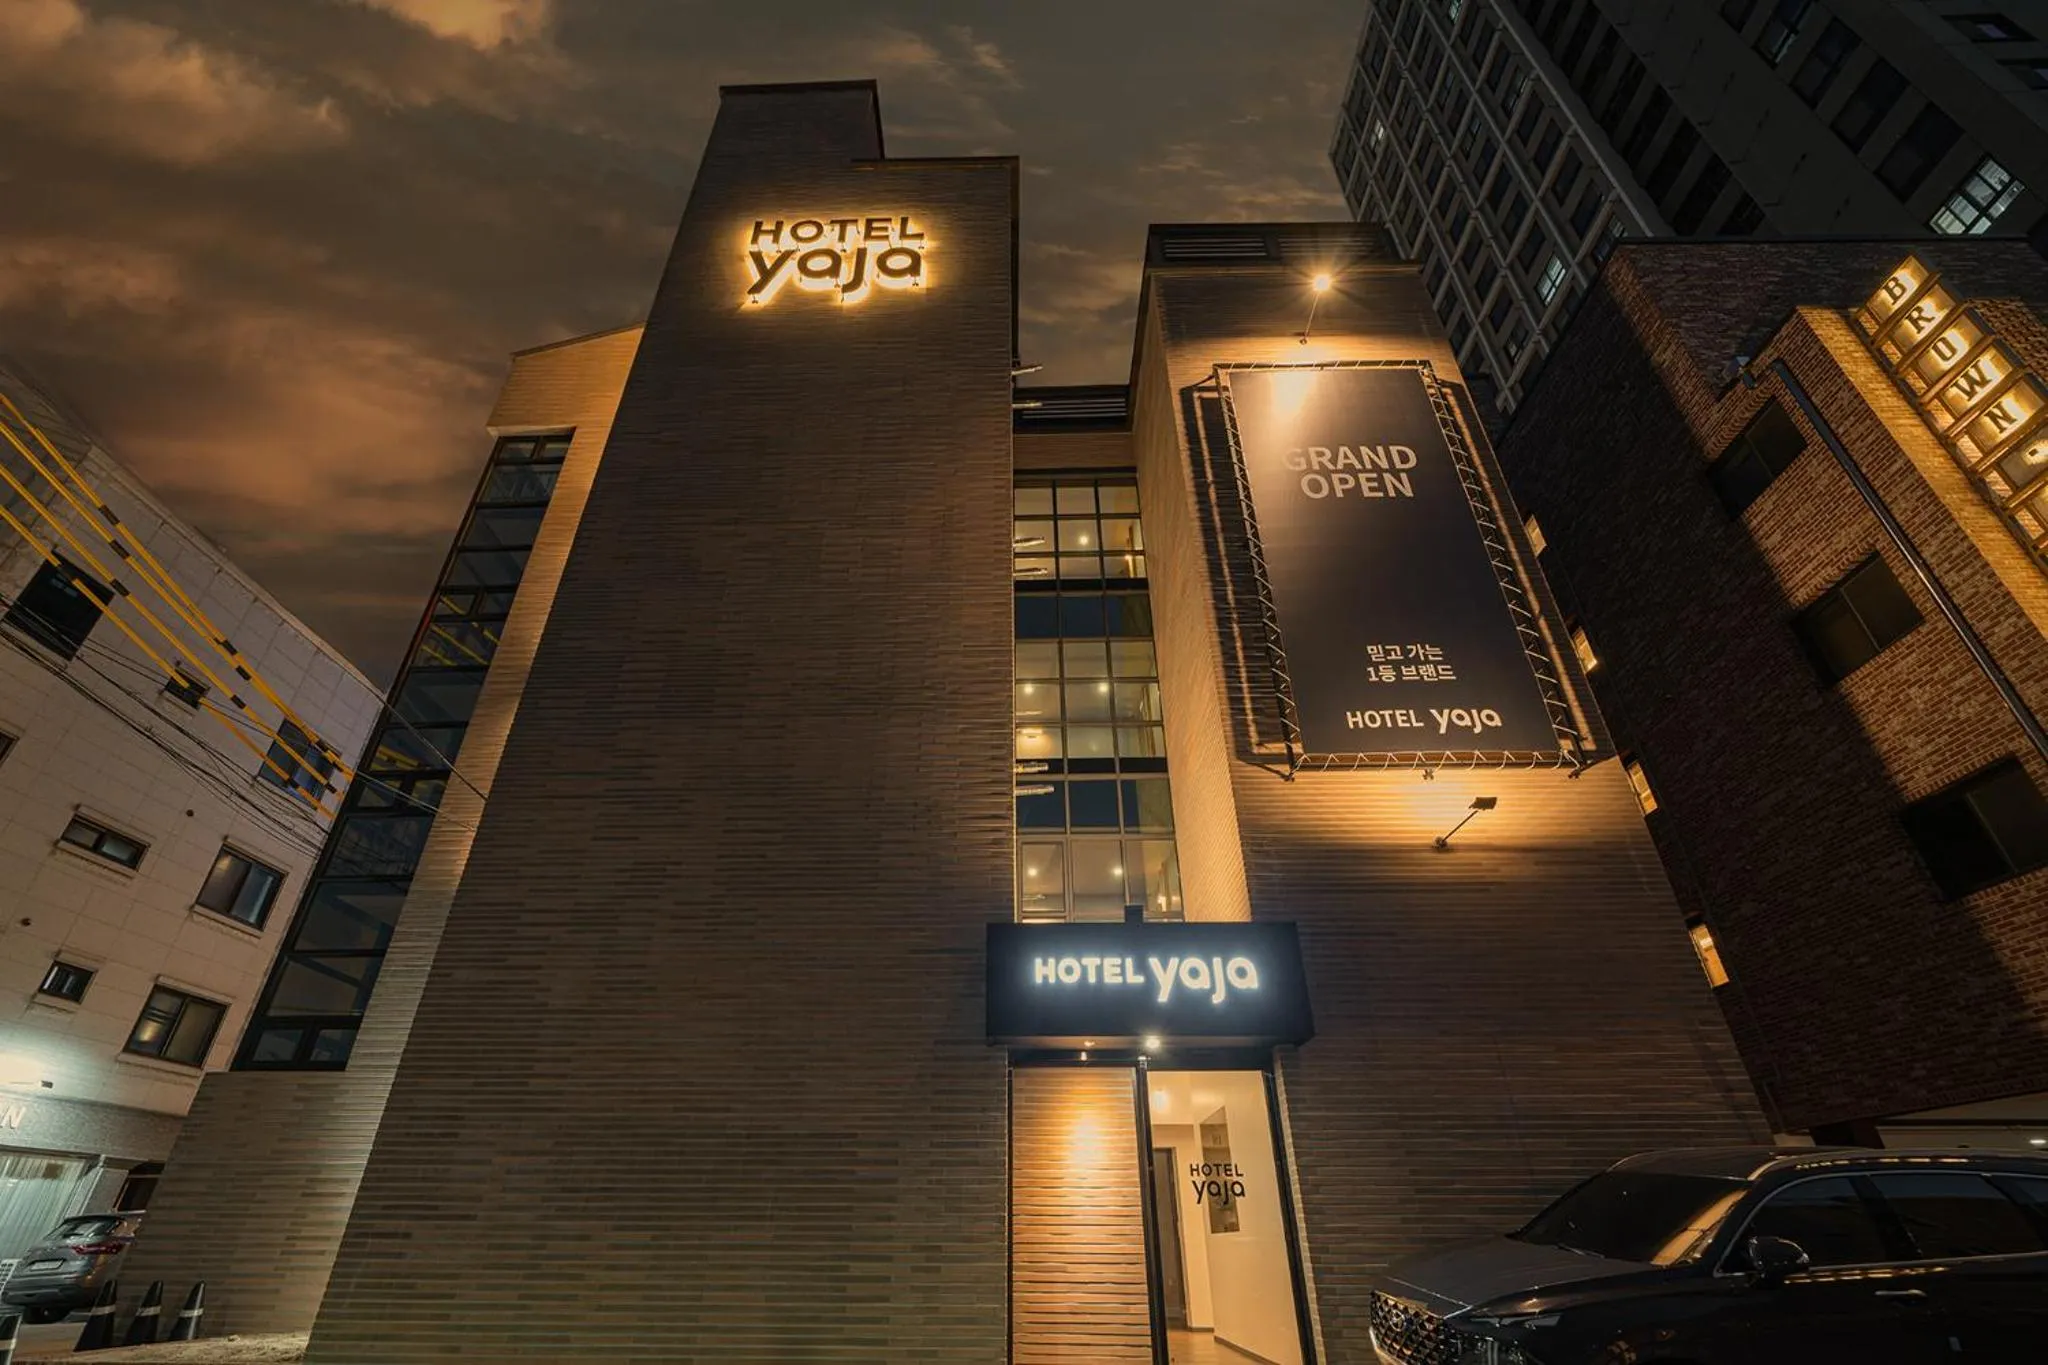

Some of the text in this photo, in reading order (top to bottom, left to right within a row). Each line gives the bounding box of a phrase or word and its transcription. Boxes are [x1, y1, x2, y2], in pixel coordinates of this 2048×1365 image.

[750, 216, 925, 245] HOTEL
[747, 247, 921, 295] yaja
[1282, 445, 1418, 471] GRAND
[1300, 472, 1414, 499] OPEN
[1366, 643, 1443, 662] 믿고 가는
[1366, 663, 1457, 682] 1등 브랜드
[1346, 708, 1502, 734] HOTEL yaja
[1034, 957, 1259, 1004] HOTEL yaja
[1189, 1163, 1244, 1177] HOTEL
[1191, 1180, 1246, 1205] yaja
